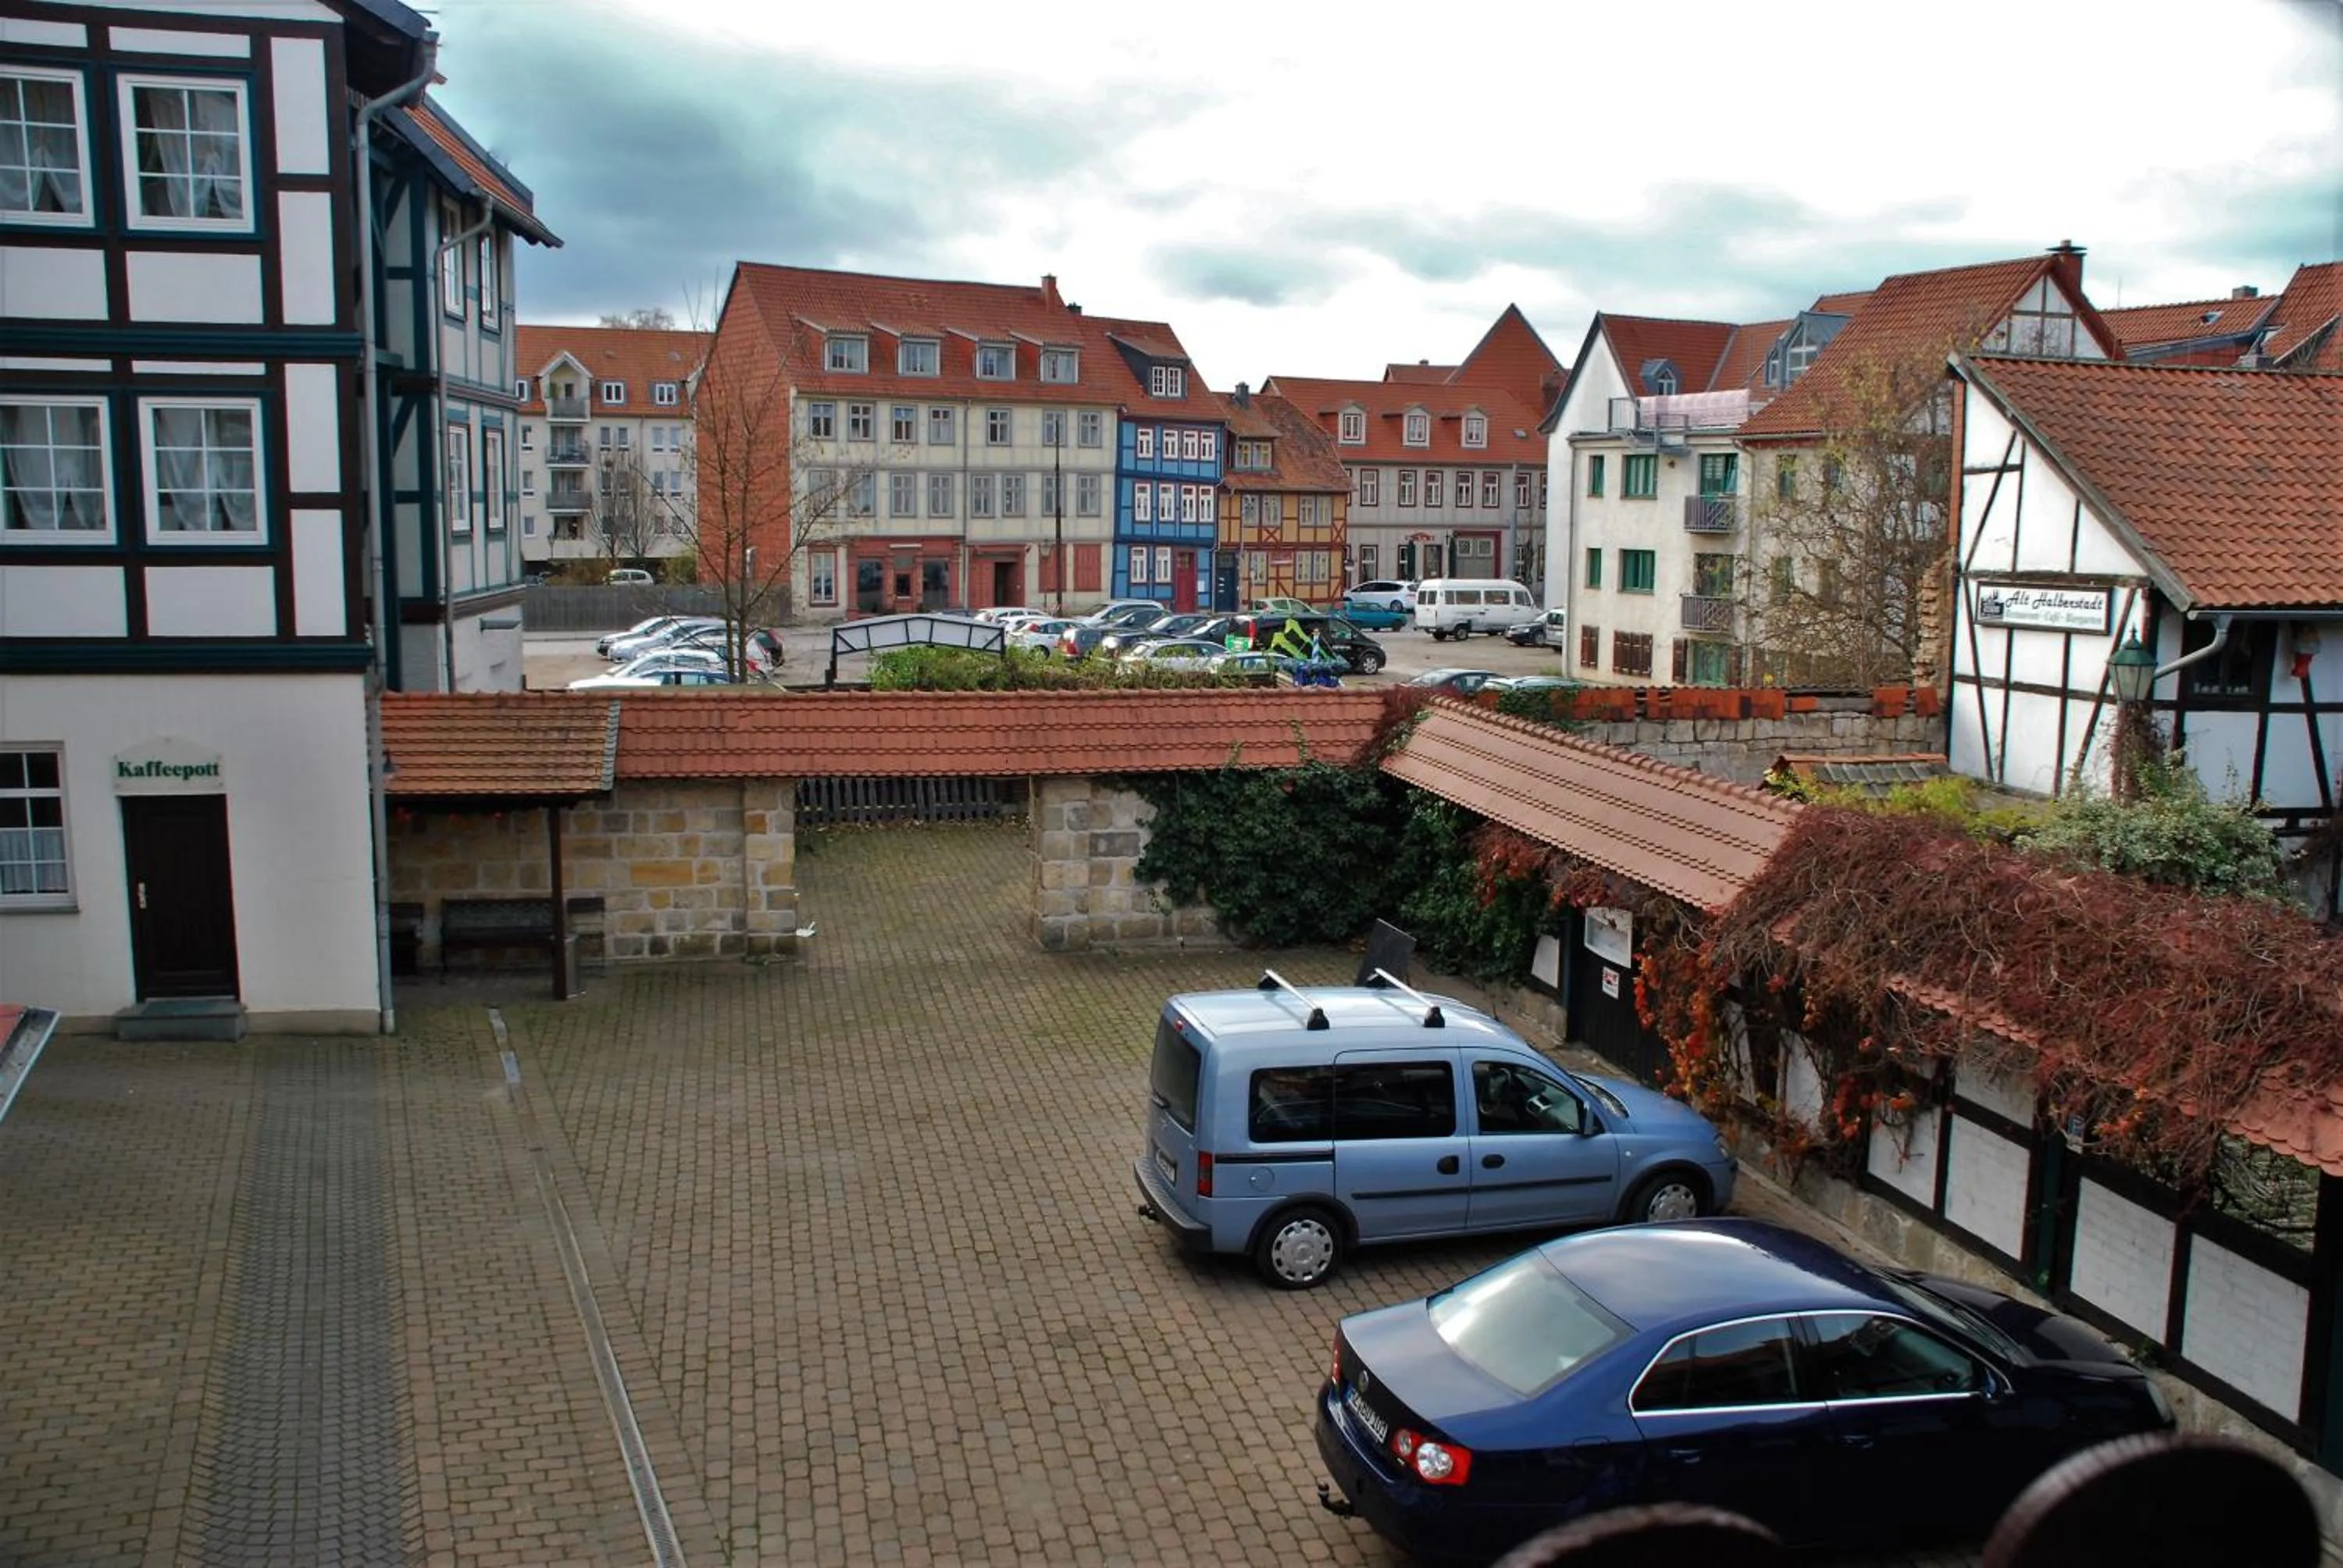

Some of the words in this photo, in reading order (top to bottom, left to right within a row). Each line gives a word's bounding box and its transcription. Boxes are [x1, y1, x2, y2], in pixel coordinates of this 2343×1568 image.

[2005, 590, 2030, 608] Alt
[2032, 592, 2103, 610] Halberstadt
[117, 761, 219, 780] Kaffeepott
